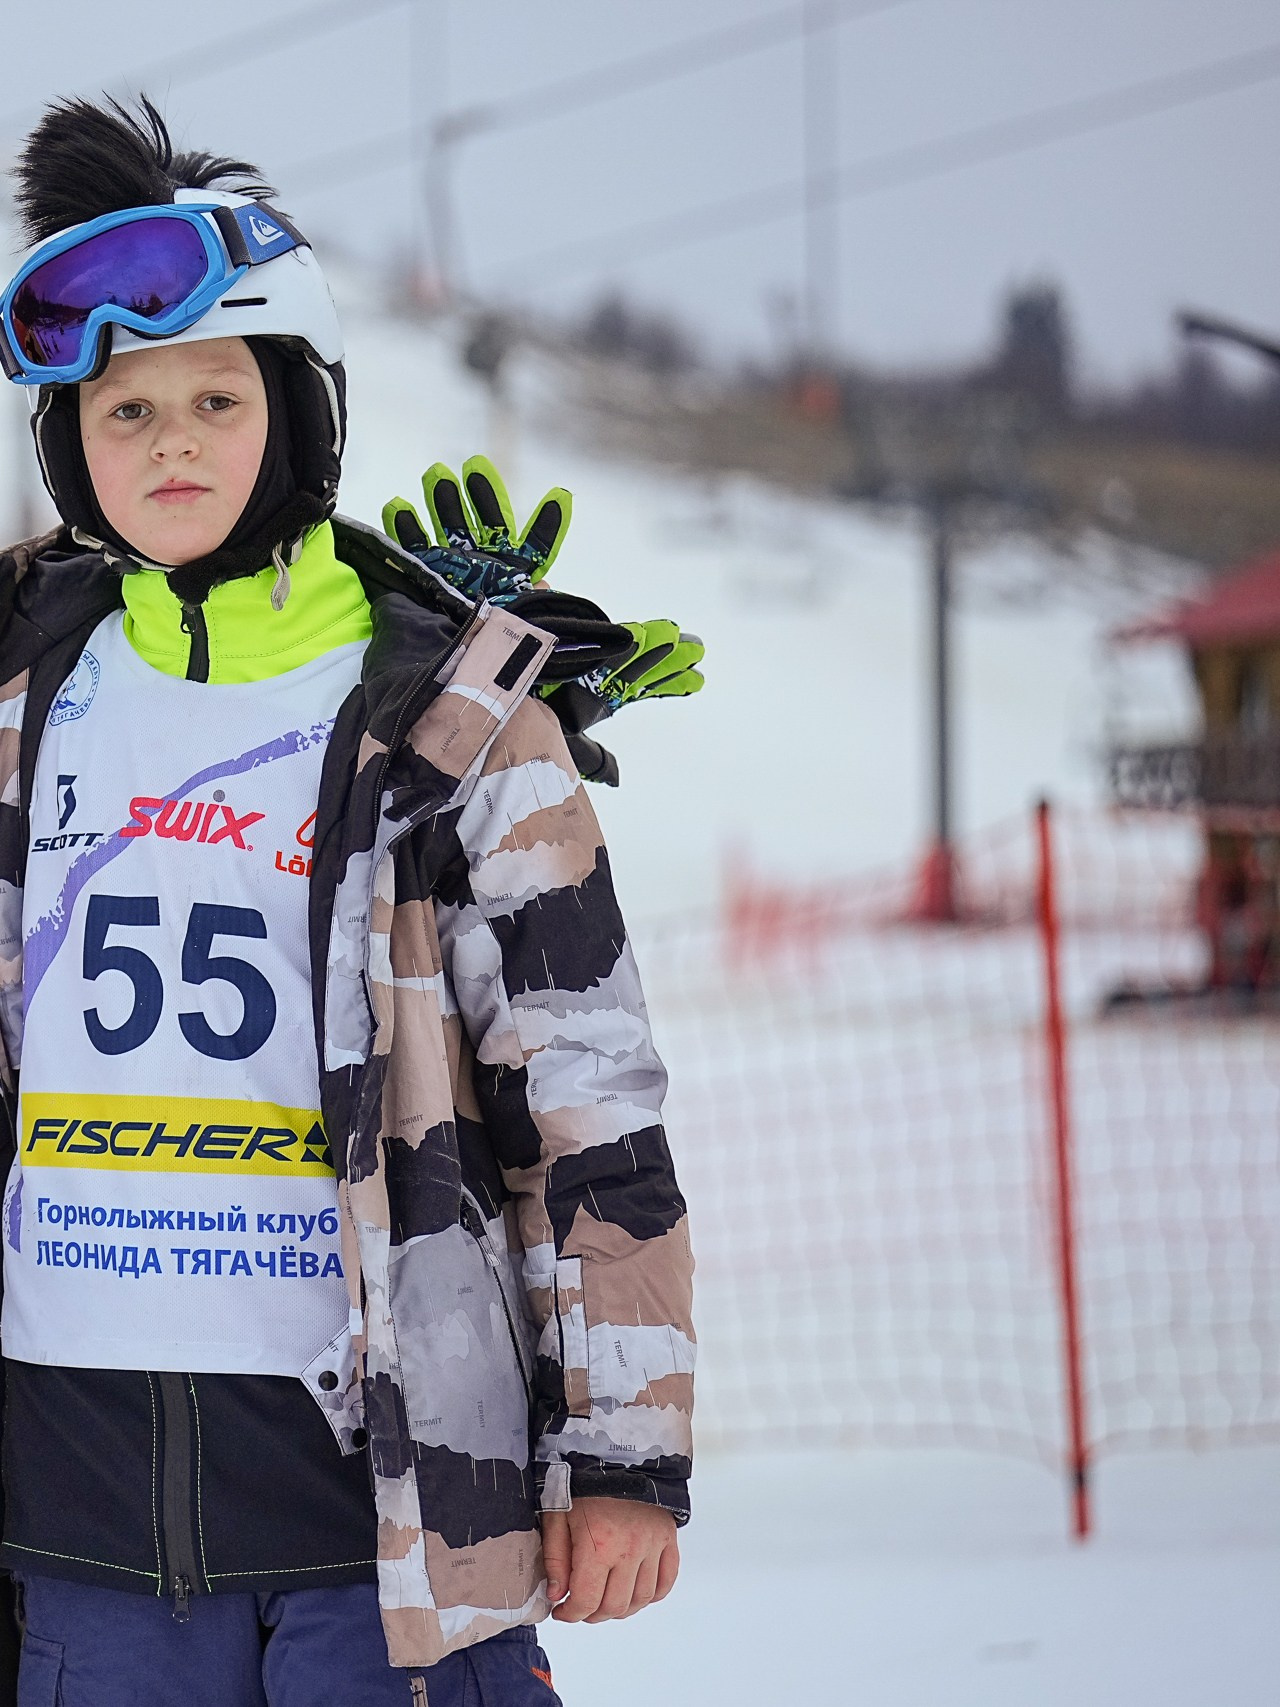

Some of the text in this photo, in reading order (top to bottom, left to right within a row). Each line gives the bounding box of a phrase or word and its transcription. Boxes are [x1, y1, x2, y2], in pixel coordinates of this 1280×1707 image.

[31, 832, 104, 853] SCOTT
[82, 894, 277, 1061] 55
[25, 1118, 299, 1162] FISCHER
[37, 1197, 338, 1241] Горнолыжный клуб
[36, 1240, 345, 1279] ЛЕОНИДА ТЯГАЧЁВА
